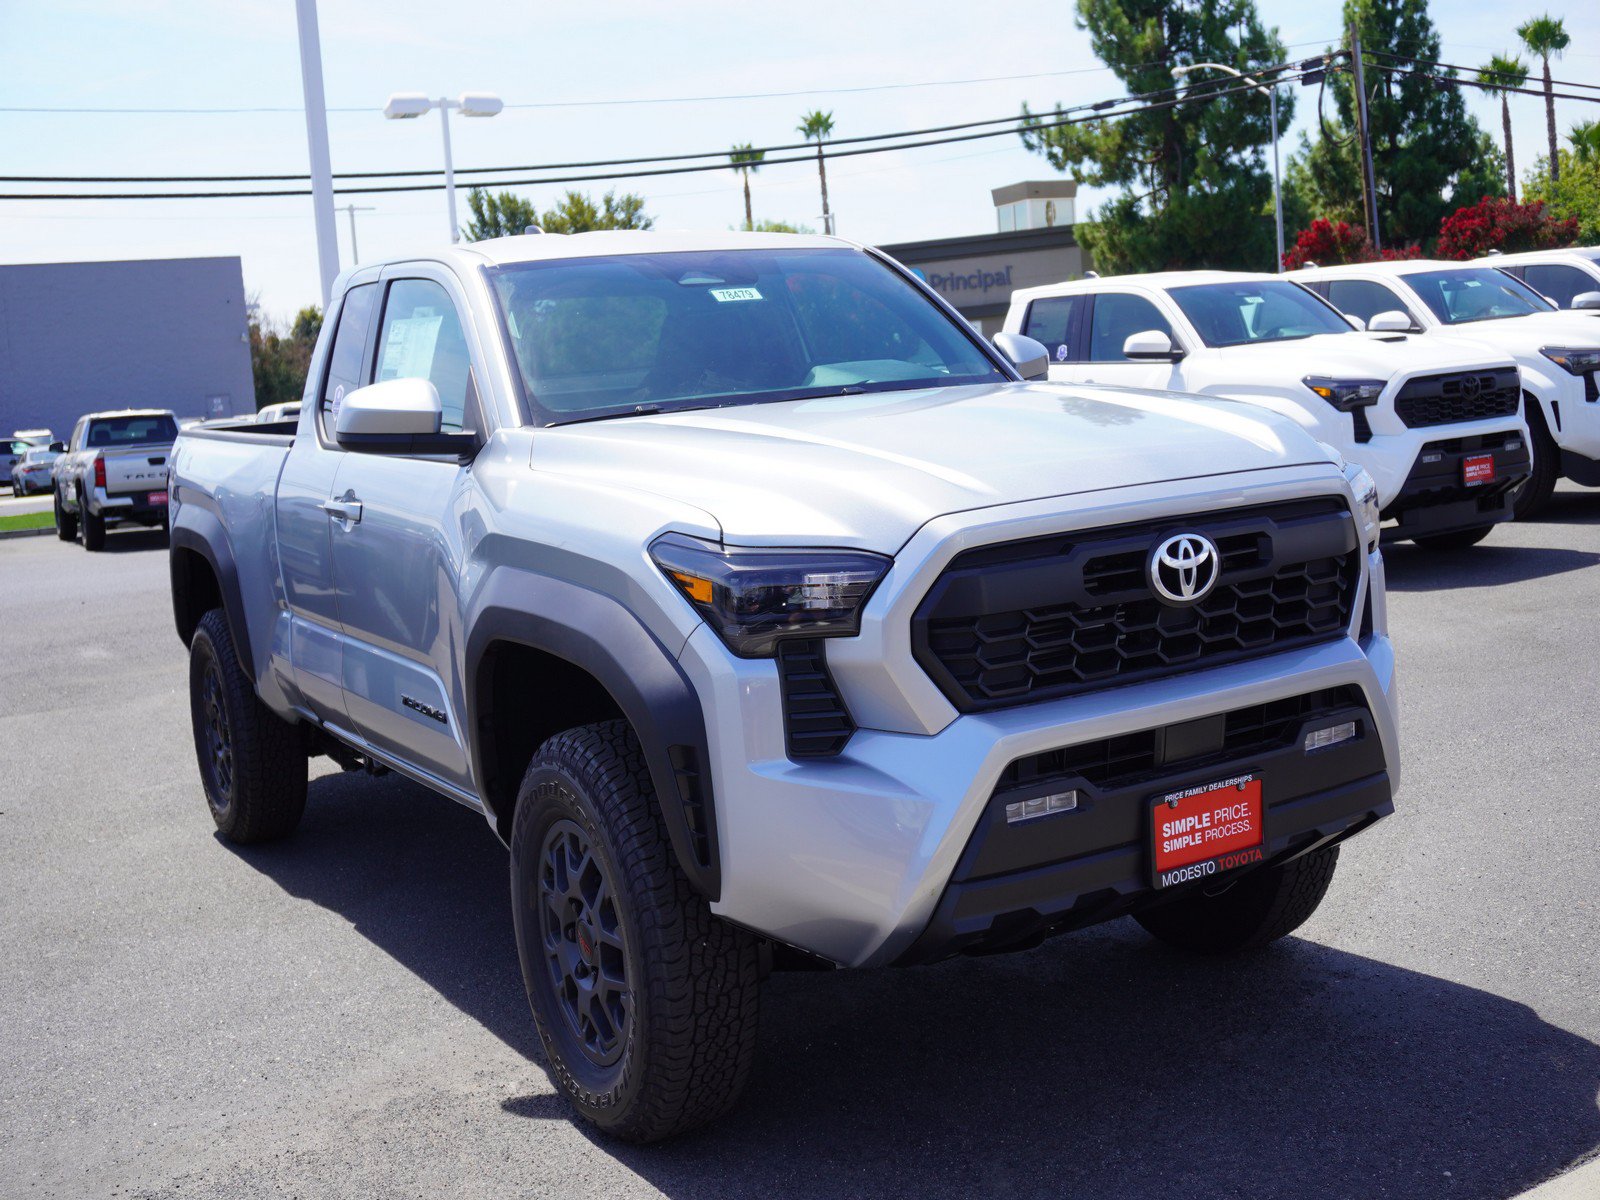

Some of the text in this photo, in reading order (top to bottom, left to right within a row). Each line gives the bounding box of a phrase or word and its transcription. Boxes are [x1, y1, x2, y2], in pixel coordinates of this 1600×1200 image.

[929, 265, 1012, 293] Principal
[719, 289, 754, 300] 78479
[1164, 775, 1253, 802] PRICE FAMILY DEALERSHIPS
[1162, 802, 1252, 838] SIMPLE PRICE.
[1163, 820, 1253, 853] SIMPLE PROCESS.
[1162, 848, 1263, 887] MODESTO TOYOTA
